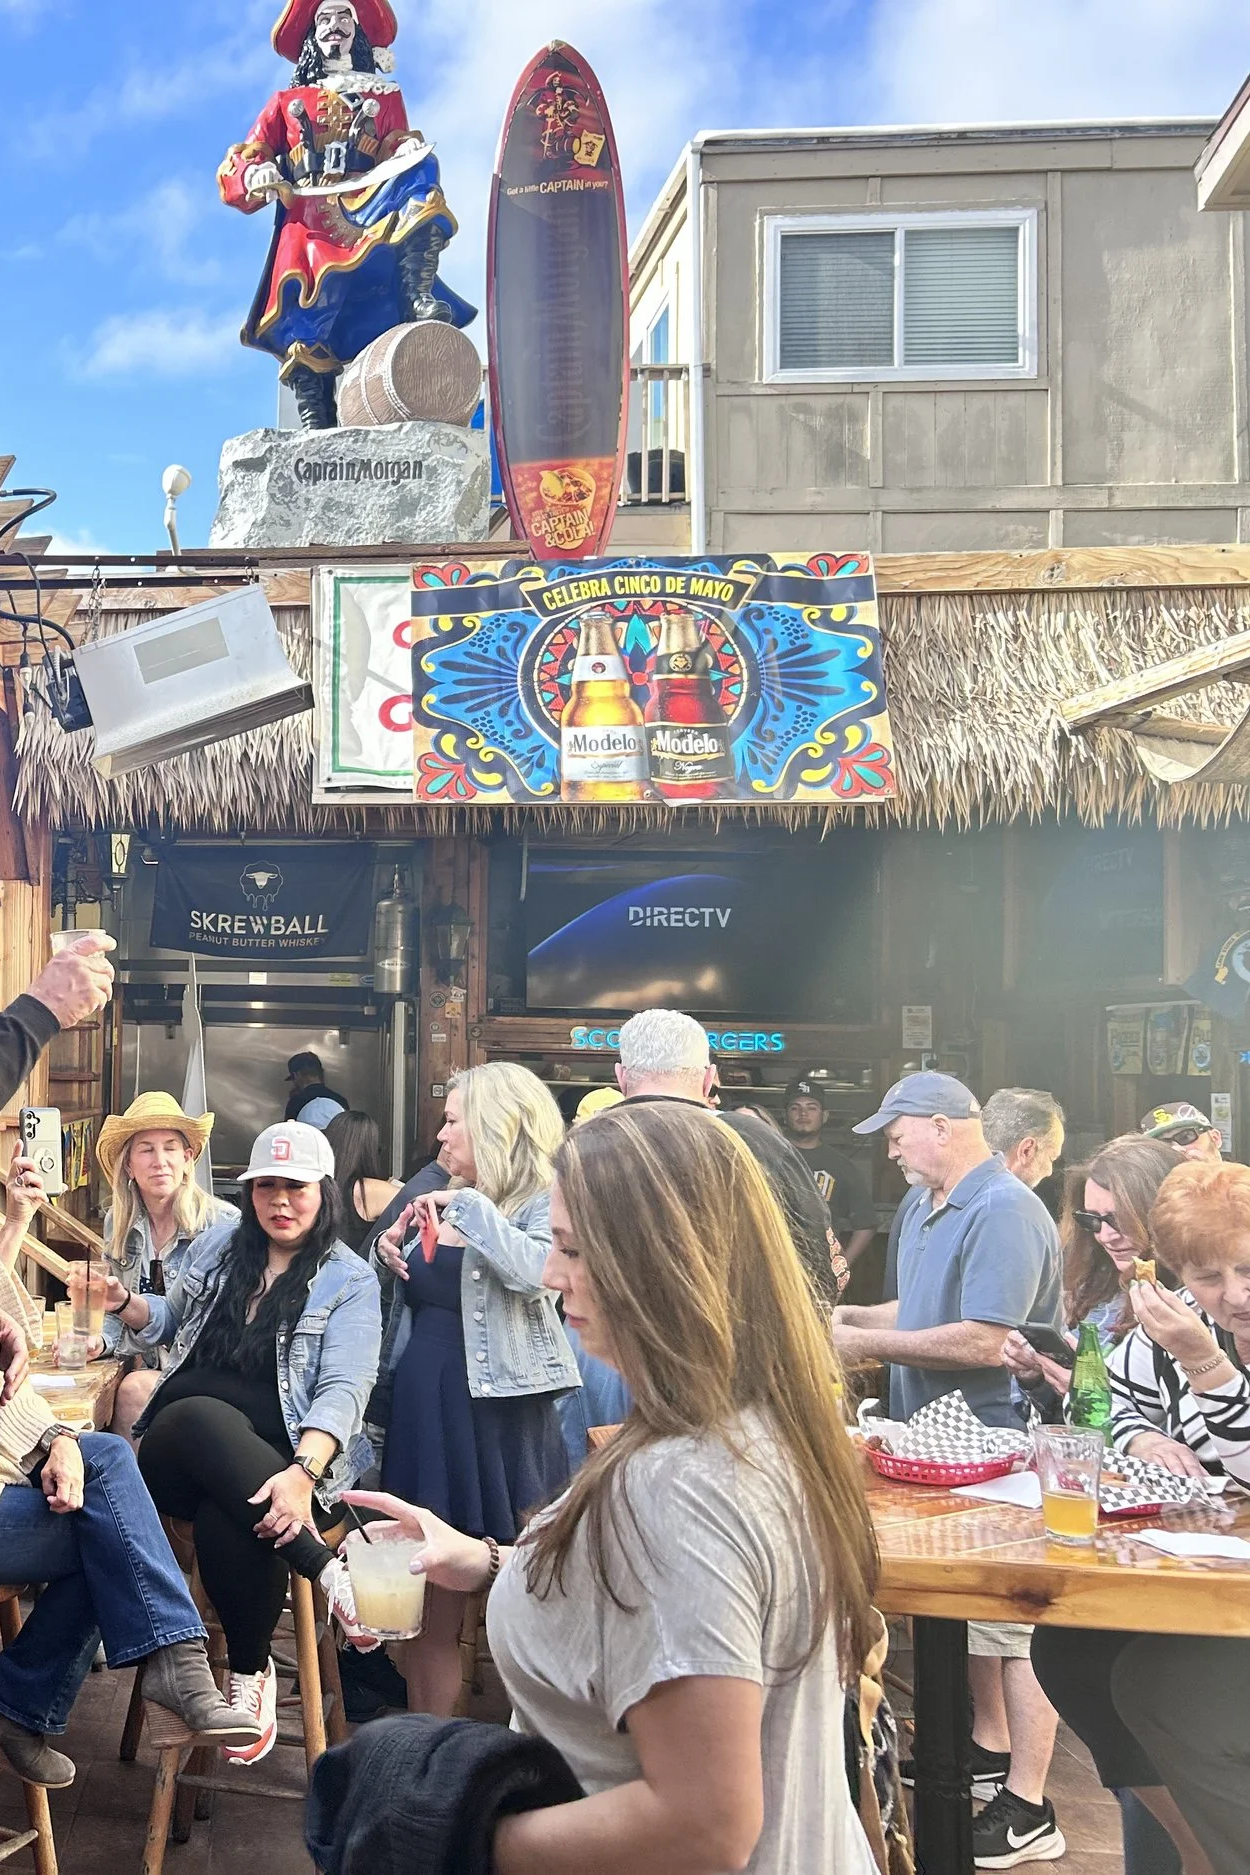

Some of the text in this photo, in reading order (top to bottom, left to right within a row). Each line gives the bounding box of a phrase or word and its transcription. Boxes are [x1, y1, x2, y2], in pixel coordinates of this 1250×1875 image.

[539, 179, 584, 194] CAPTAIN
[294, 457, 423, 486] Captain Morgan
[531, 508, 590, 537] CAPTAIN
[542, 575, 734, 611] CELEBRA CINCO DE MAYO
[573, 733, 637, 753] Modelo
[655, 729, 719, 755] Modelo
[190, 910, 329, 936] SKREWBALL
[628, 906, 732, 929] DIRECTV
[188, 931, 327, 949] PEANUT BUTTER WHISKEY
[706, 1030, 785, 1051] RGERS
